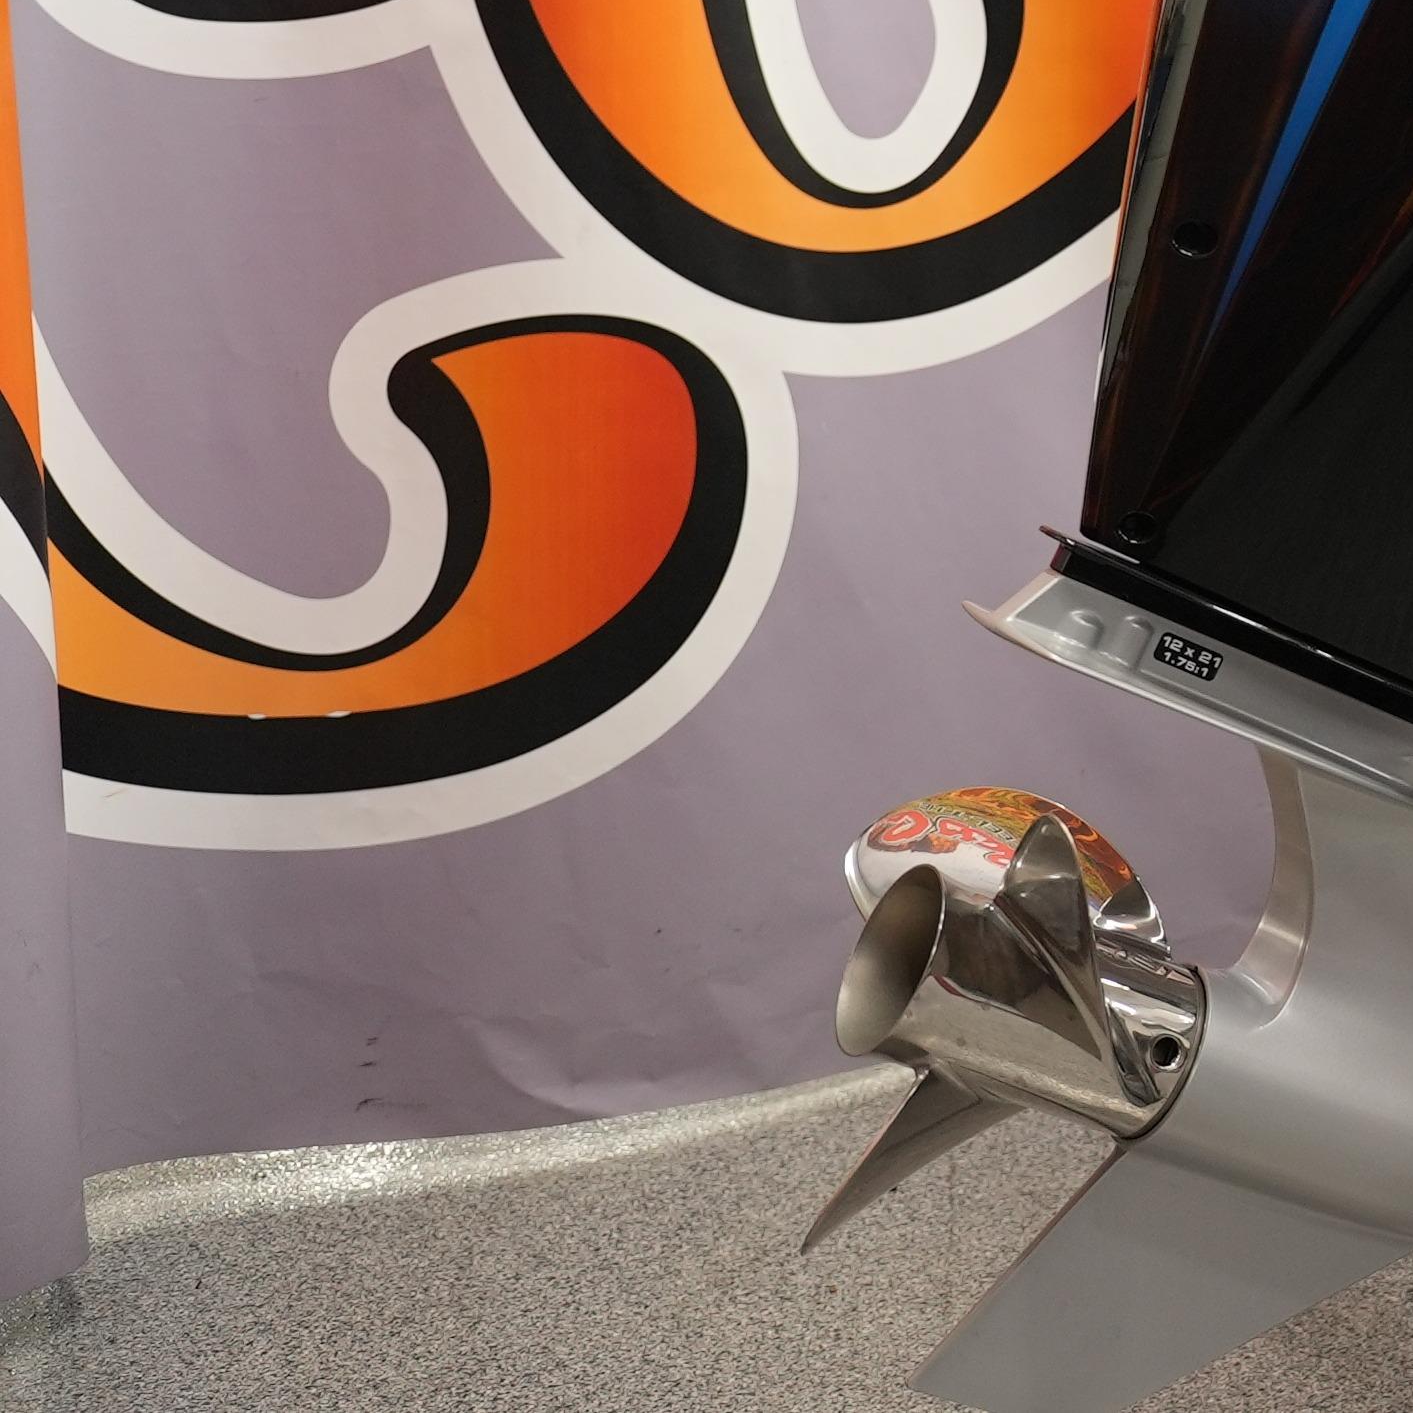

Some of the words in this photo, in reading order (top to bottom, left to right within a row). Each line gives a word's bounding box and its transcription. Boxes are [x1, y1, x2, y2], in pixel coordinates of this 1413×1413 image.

[1163, 635, 1184, 653] 12
[1184, 647, 1196, 658] x
[1198, 651, 1223, 669] 21
[1163, 651, 1209, 678] 1.75:1
